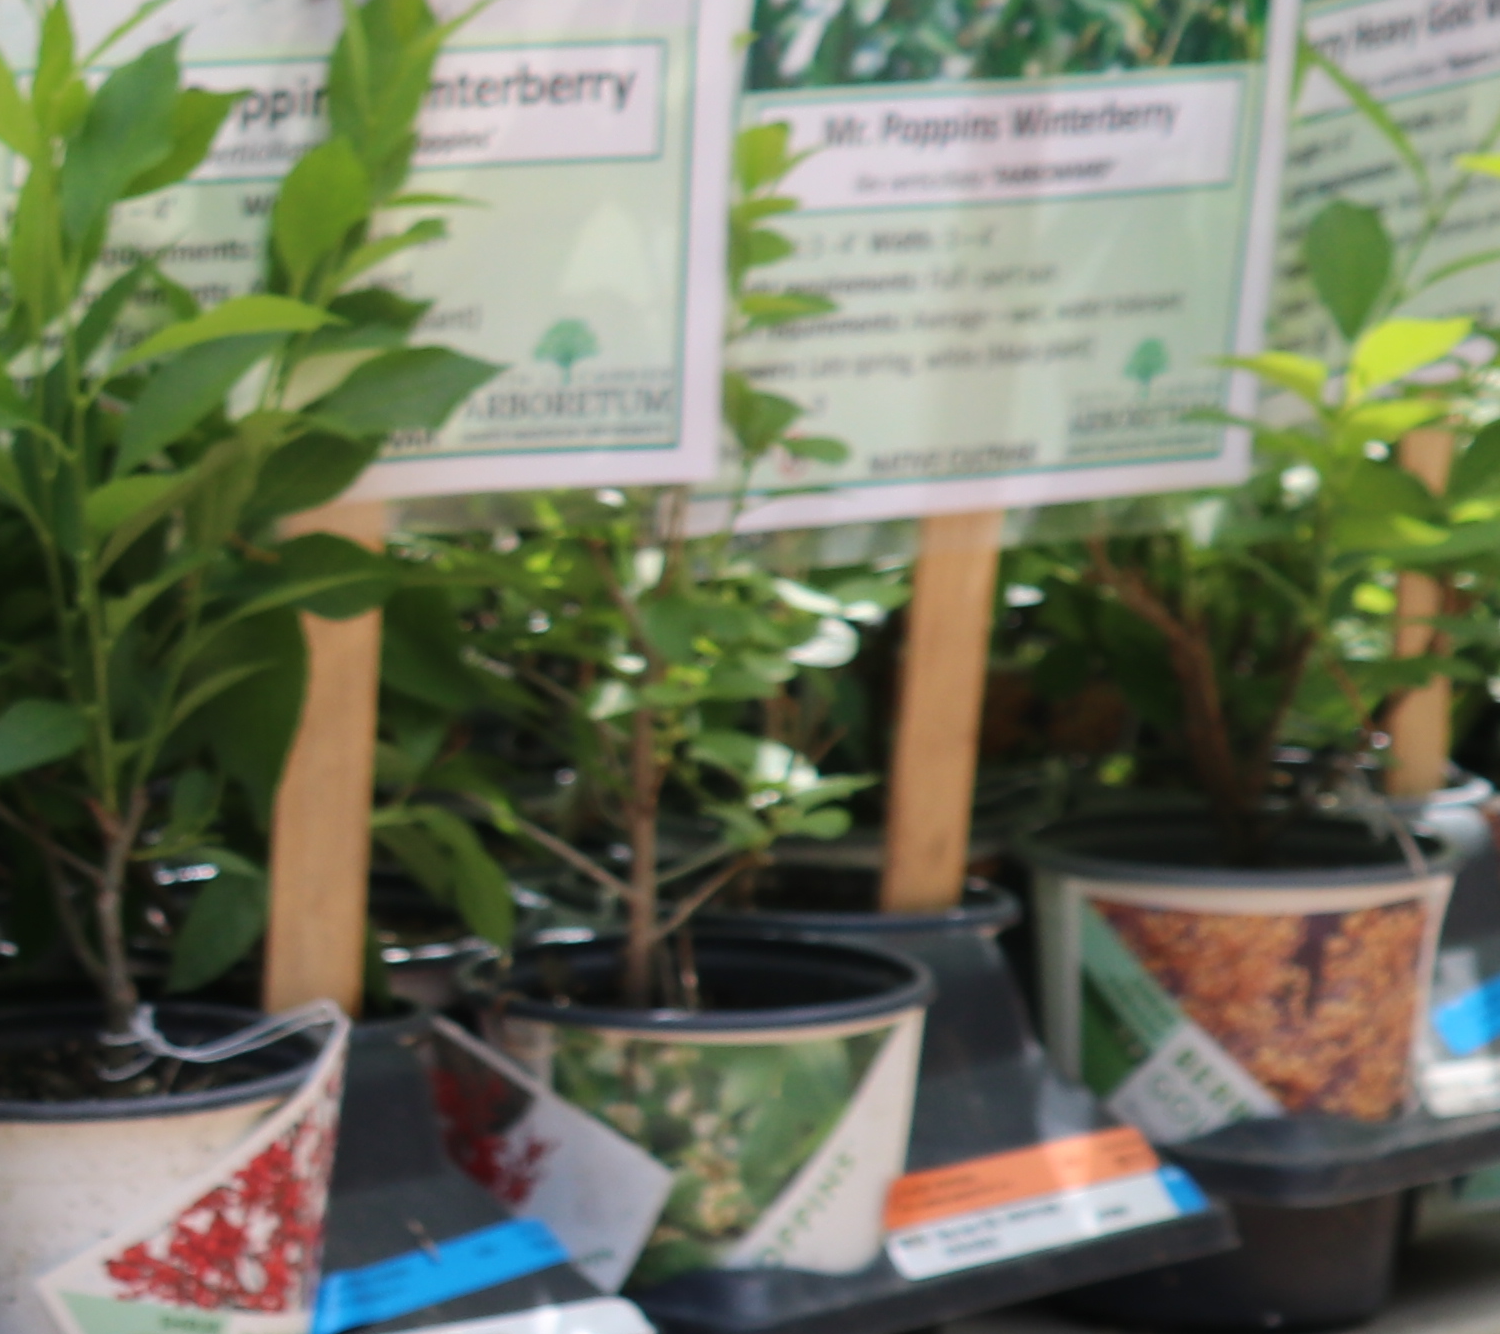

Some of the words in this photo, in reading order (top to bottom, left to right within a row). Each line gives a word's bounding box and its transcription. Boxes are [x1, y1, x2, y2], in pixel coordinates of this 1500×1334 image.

[429, 65, 636, 114] nterberry
[883, 110, 1000, 152] Poppins
[1014, 97, 1181, 138] Winterberry
